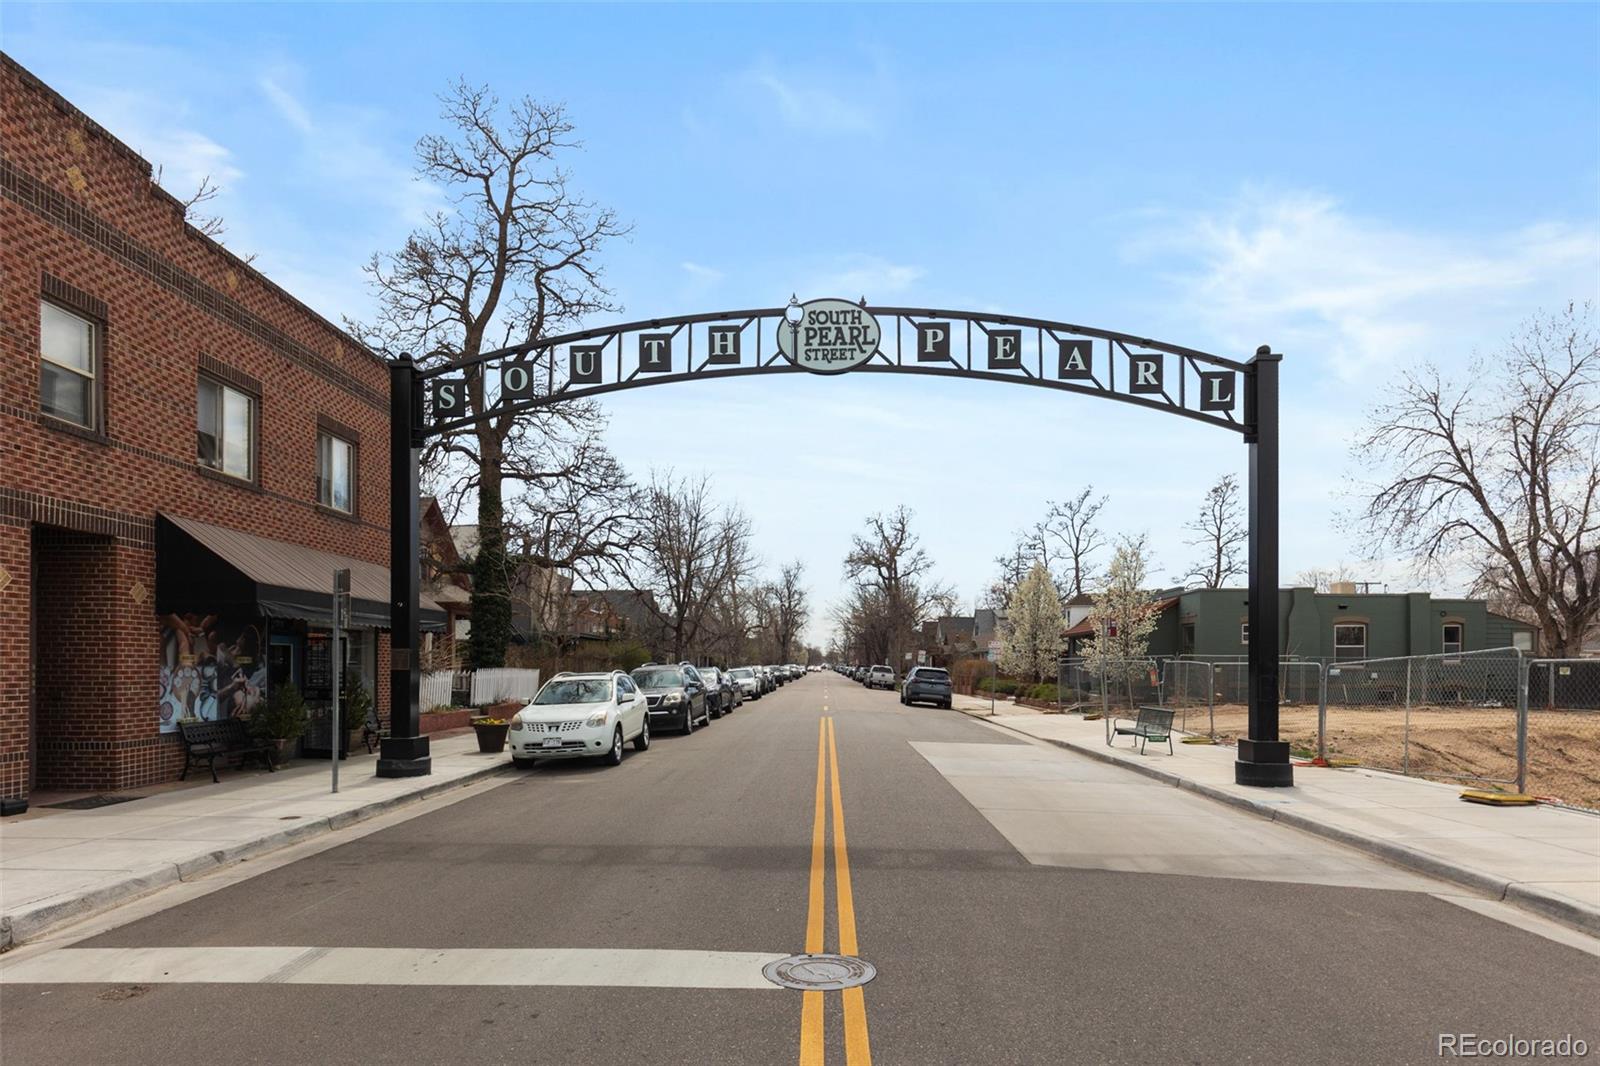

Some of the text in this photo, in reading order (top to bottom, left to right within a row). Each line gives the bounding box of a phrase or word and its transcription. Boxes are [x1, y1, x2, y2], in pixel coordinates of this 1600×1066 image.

[808, 310, 862, 326] SOUTH
[804, 325, 876, 353] PEARL
[804, 348, 857, 364] STREET
[438, 328, 1232, 410] SOUTH PEARL
